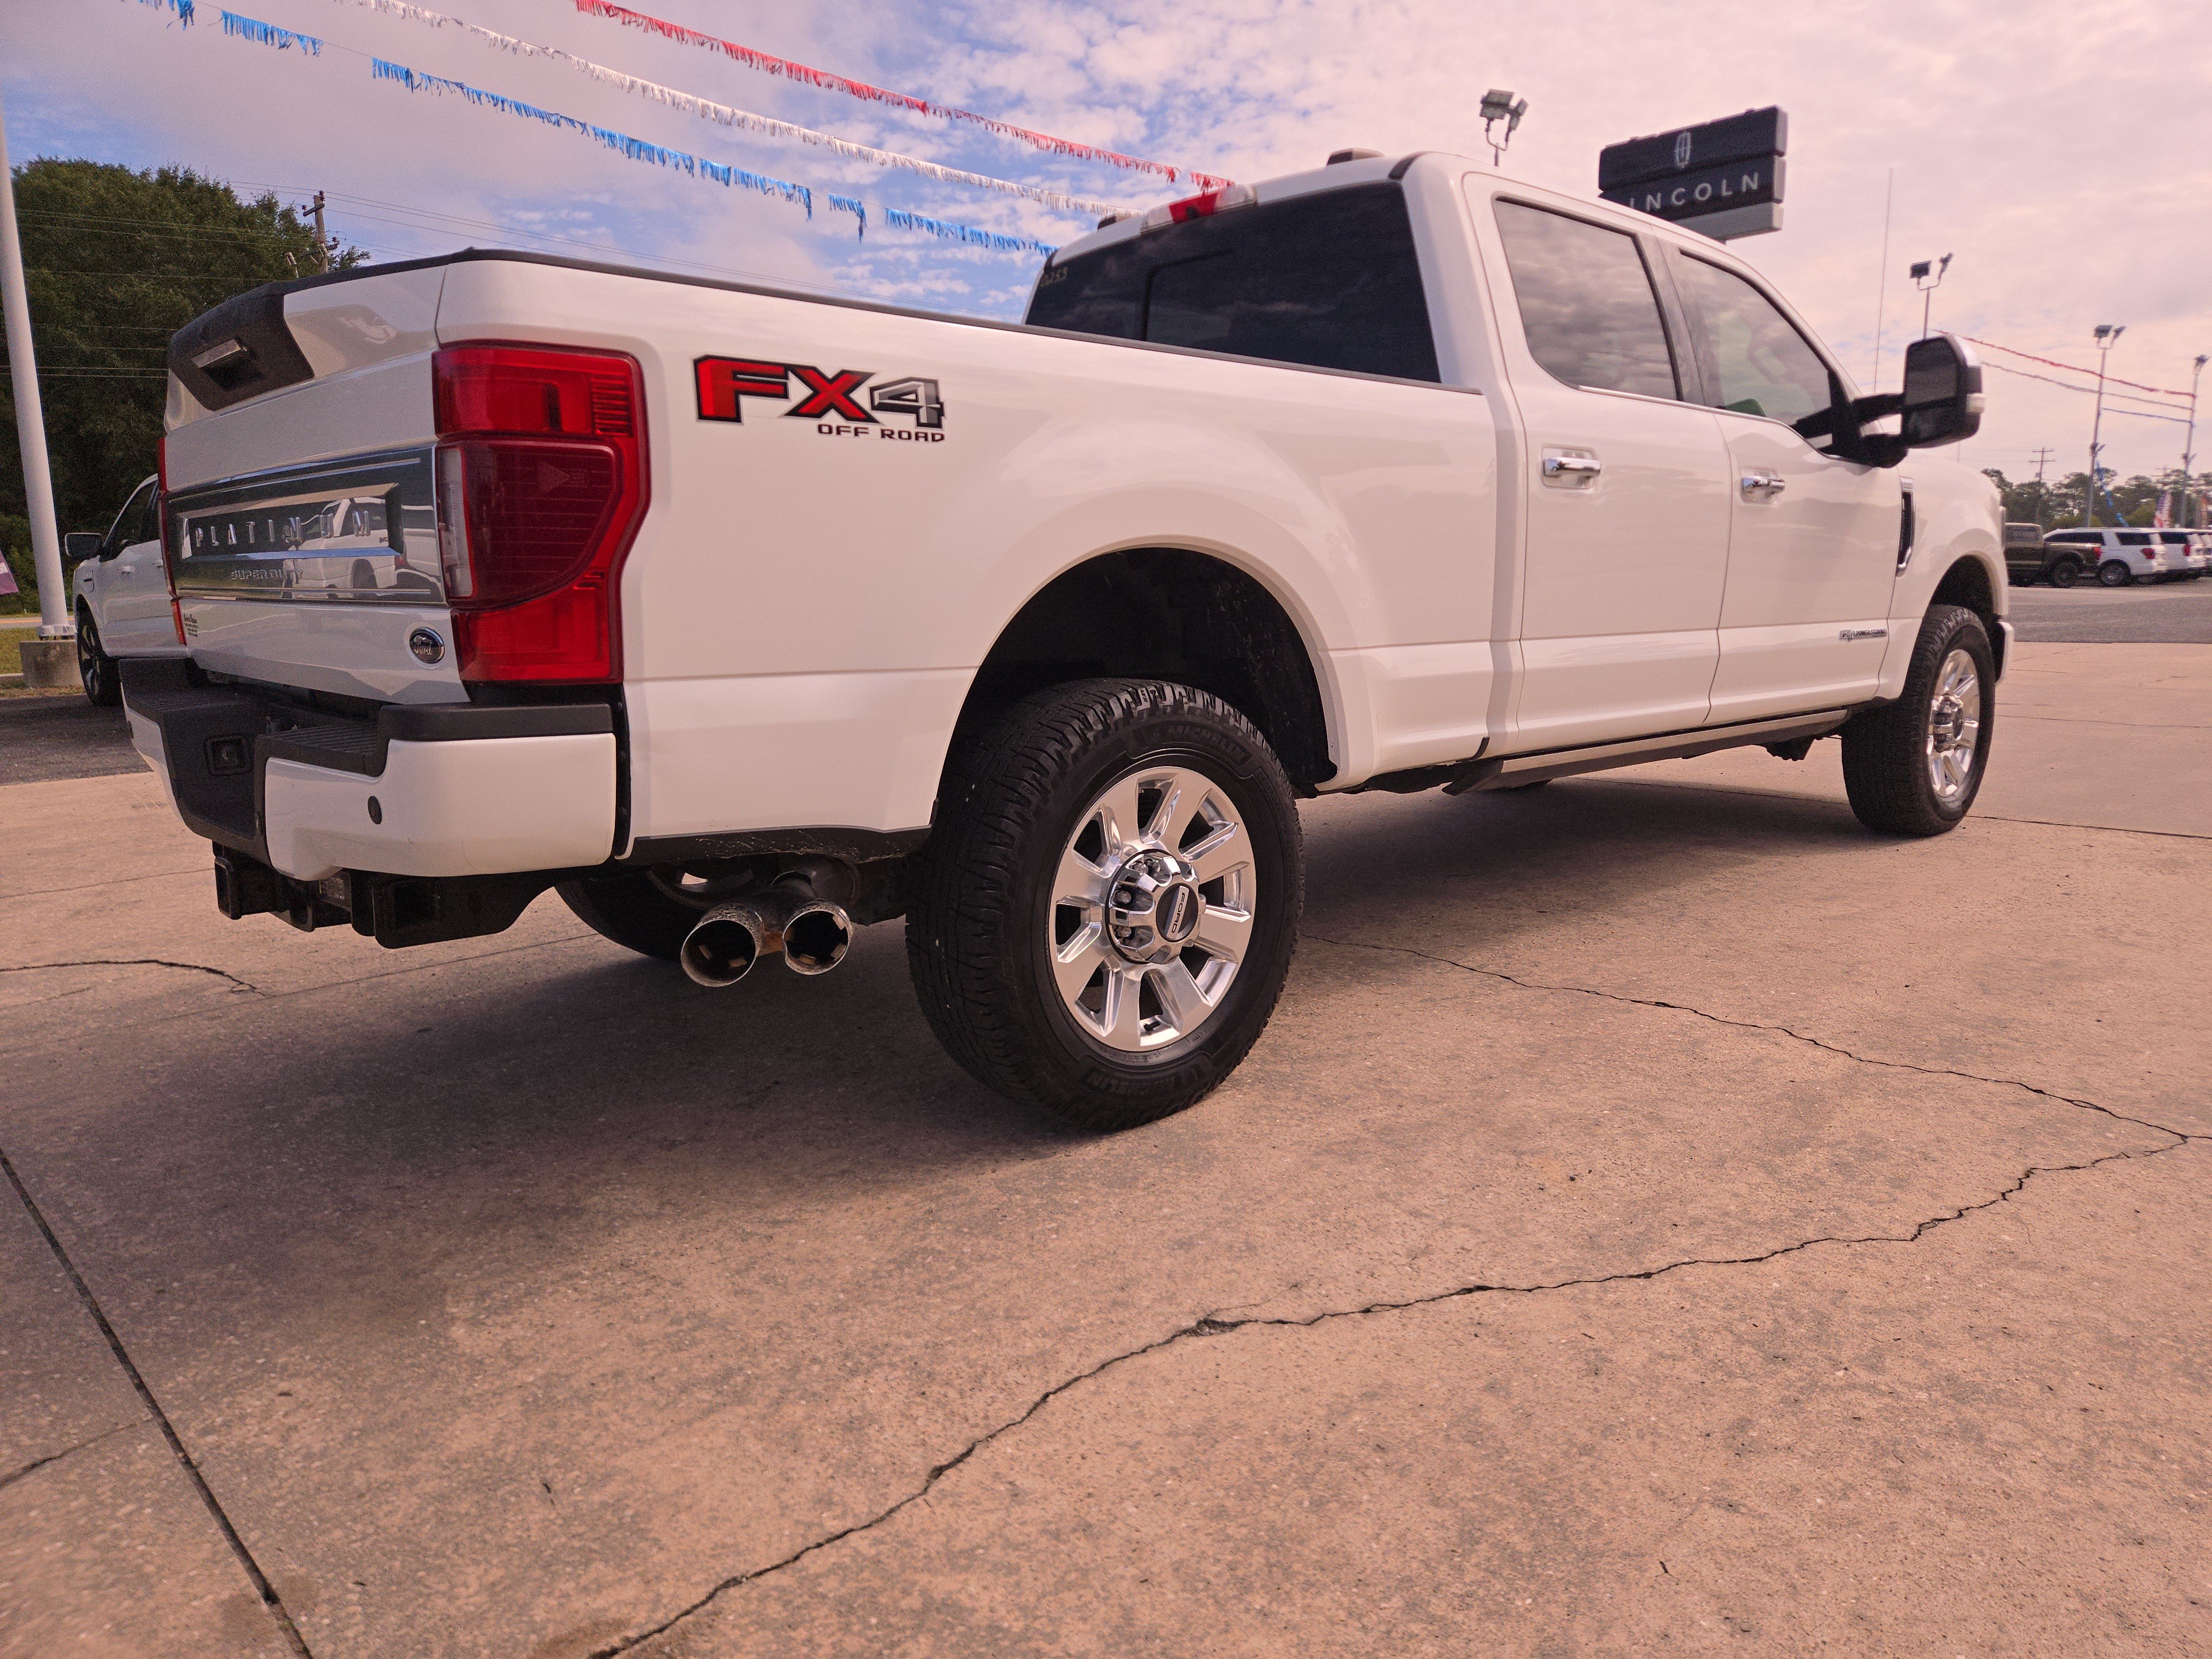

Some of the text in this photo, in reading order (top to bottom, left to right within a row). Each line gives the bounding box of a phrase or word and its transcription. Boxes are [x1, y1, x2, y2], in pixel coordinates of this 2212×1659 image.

[1630, 172, 1759, 213] INCOLN
[693, 354, 946, 429] FX4
[818, 423, 945, 442] OFF ROAD
[195, 510, 371, 546] PLATINUM
[230, 569, 267, 580] SUPER
[413, 634, 433, 655] Ford
[1167, 725, 1246, 762] MICHELIN
[1172, 892, 1185, 933] FORD
